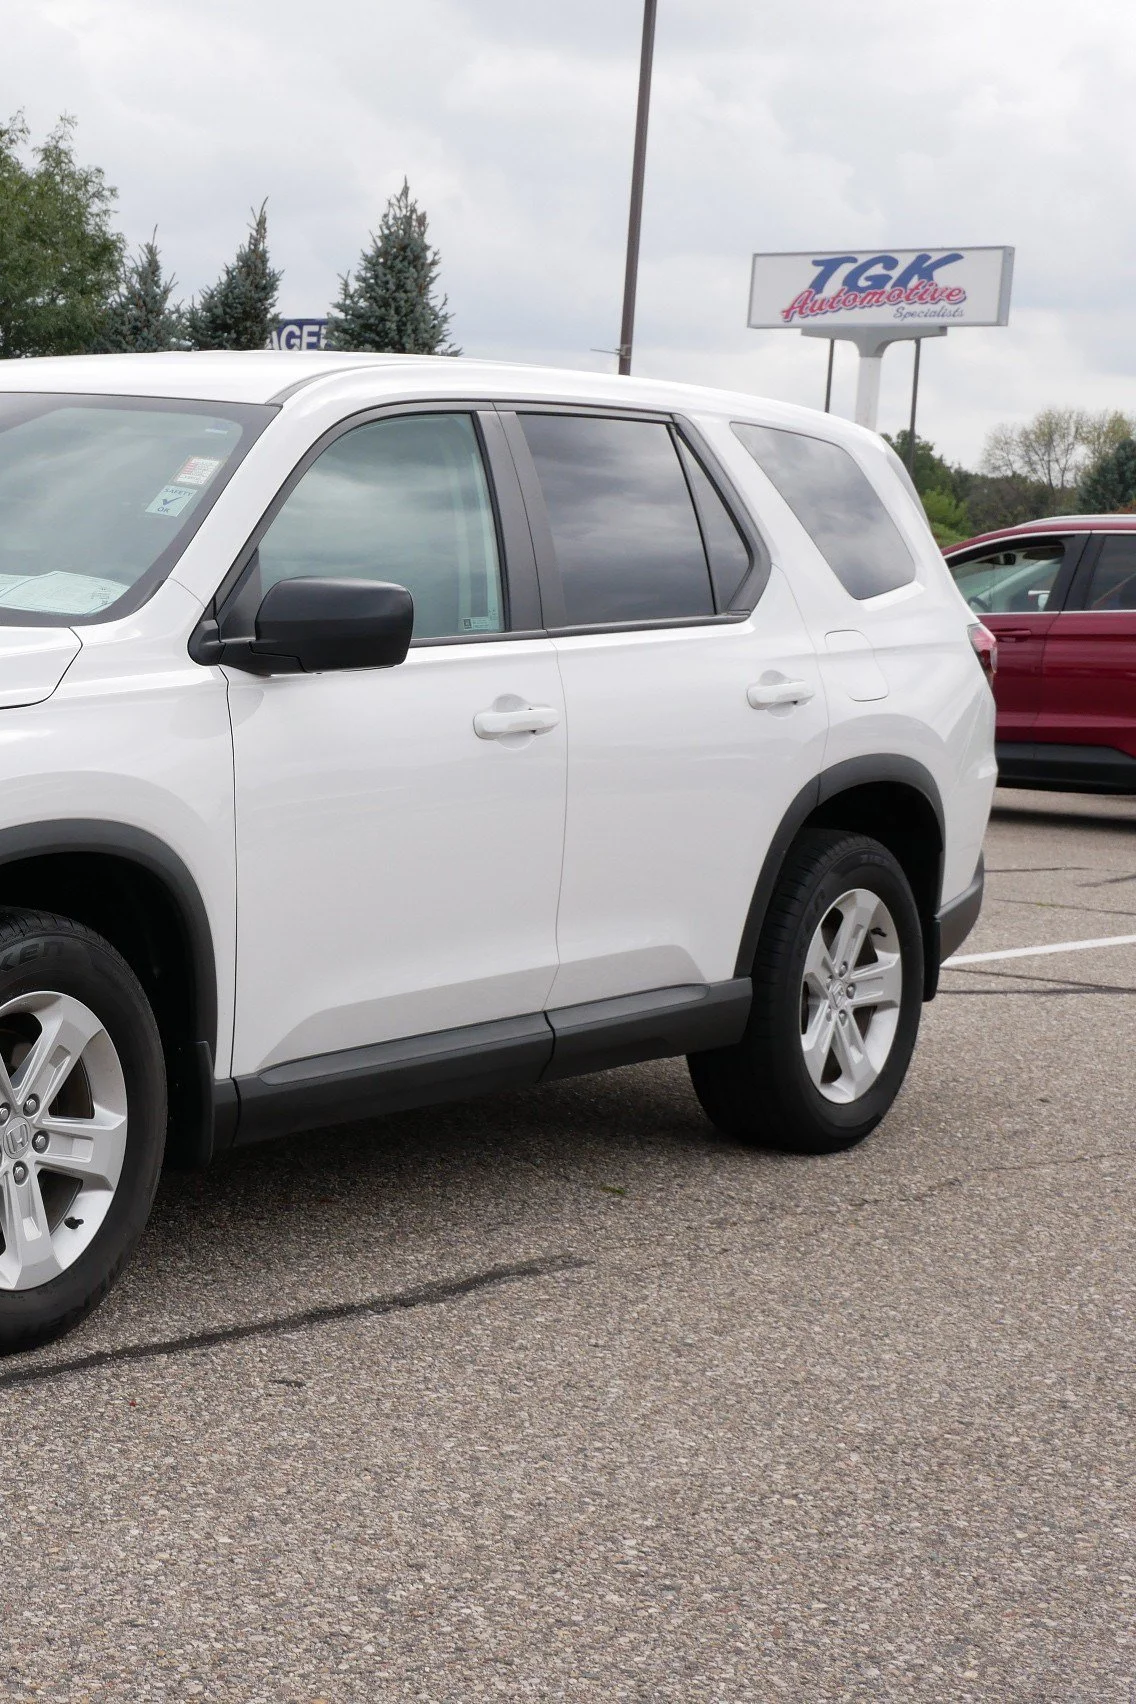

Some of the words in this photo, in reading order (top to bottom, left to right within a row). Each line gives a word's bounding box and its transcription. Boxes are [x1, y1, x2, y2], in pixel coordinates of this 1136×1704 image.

[808, 253, 964, 294] TGK
[781, 279, 967, 323] Automotive
[893, 306, 965, 321] Specialists
[164, 488, 193, 496] SAFETY
